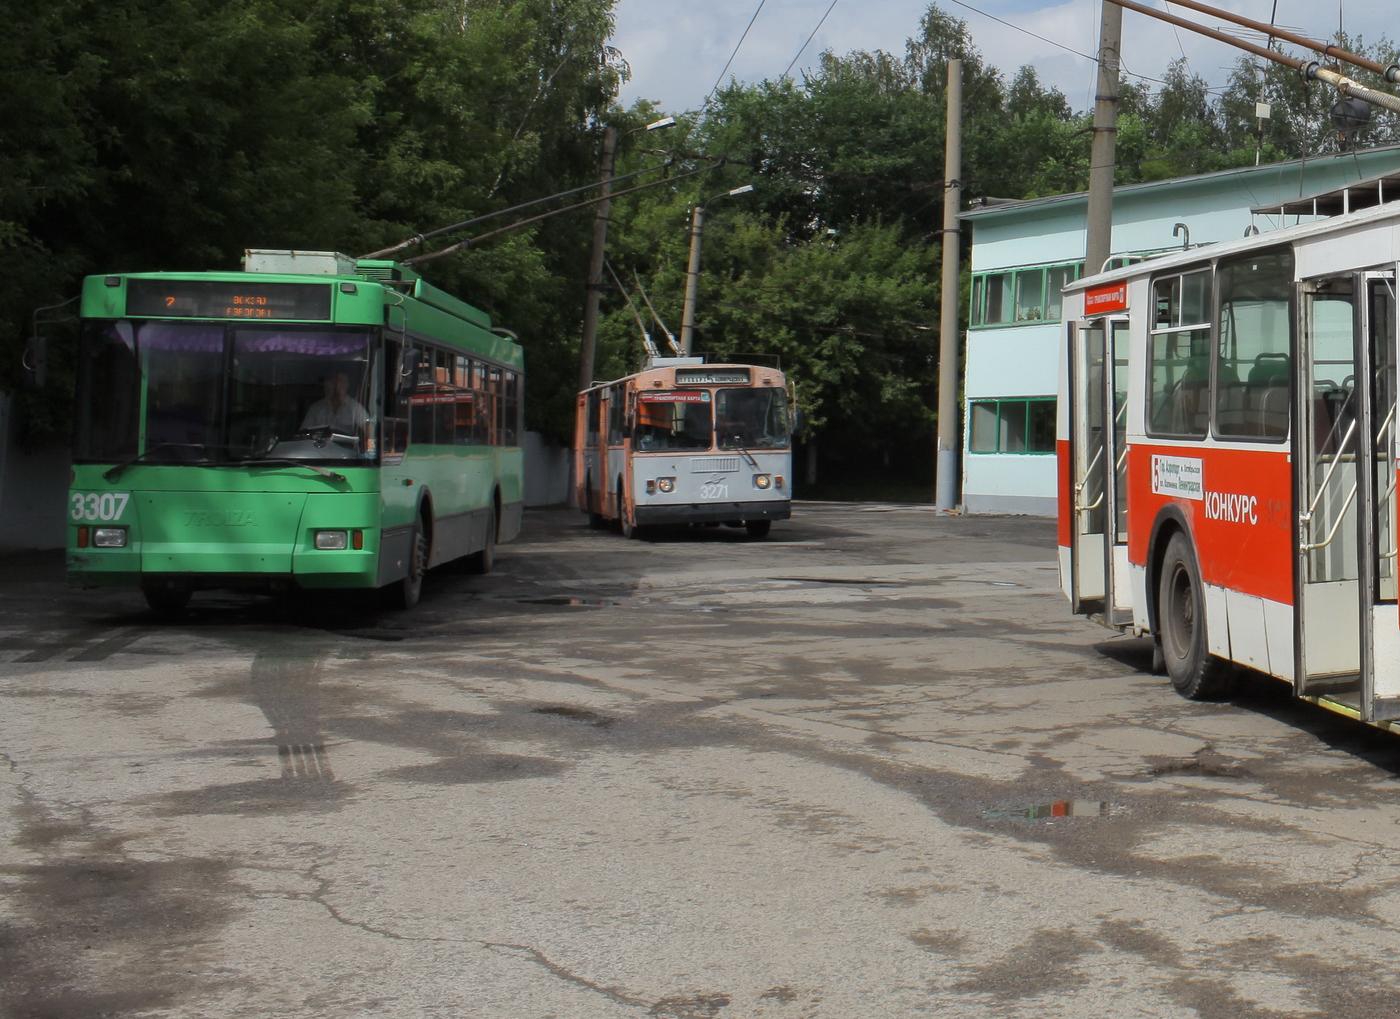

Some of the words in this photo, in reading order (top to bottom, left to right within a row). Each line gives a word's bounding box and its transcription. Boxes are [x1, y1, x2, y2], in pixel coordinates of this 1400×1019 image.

[1154, 457, 1159, 492] 5
[71, 492, 130, 521] 3307
[700, 484, 729, 499] 3271
[1205, 491, 1258, 525] КОНКУРС
